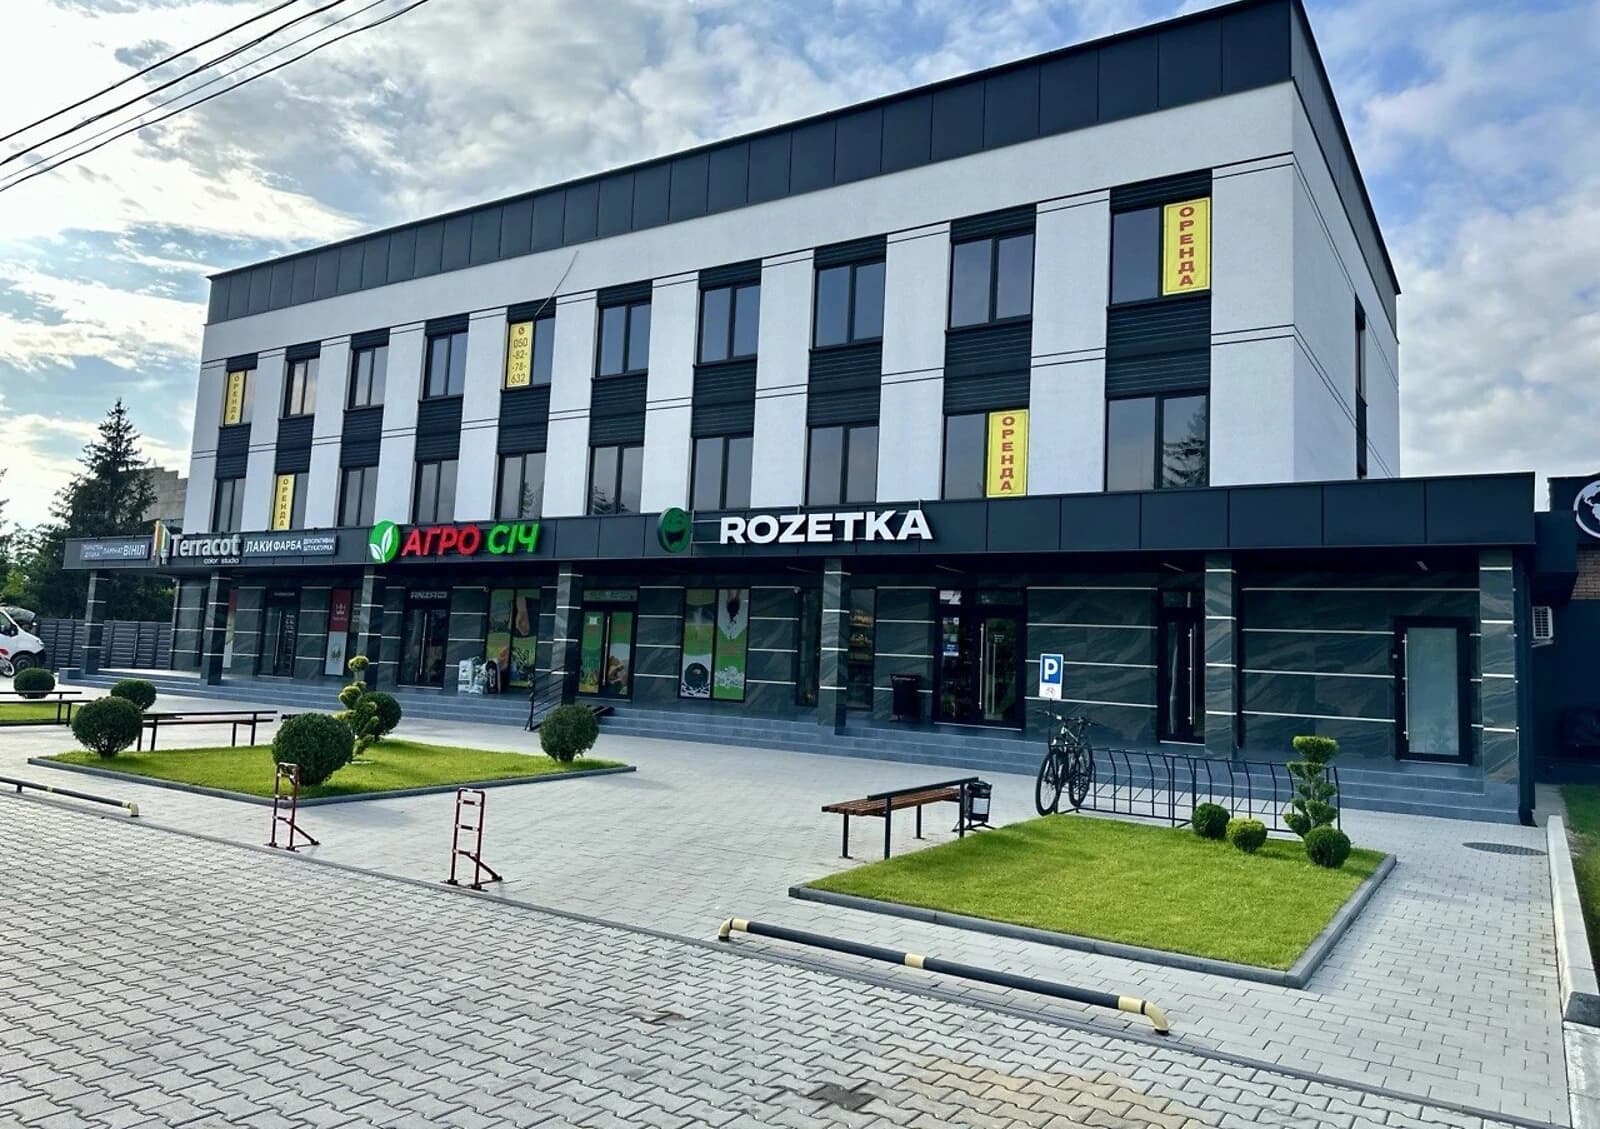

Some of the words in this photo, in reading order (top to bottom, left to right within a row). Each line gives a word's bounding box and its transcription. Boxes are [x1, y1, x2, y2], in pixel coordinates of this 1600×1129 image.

[1178, 206, 1195, 287] ОРЕНДА
[1000, 416, 1015, 491] ОРЕНДА
[279, 478, 289, 527] ОРЕНДА
[400, 524, 481, 557] АГРО
[486, 522, 539, 555] СІЧ
[719, 509, 933, 545] ROZETKA
[123, 544, 146, 557] ВІНІЛ
[170, 533, 241, 557] Terracot
[245, 540, 273, 553] ЛАКИ
[273, 540, 302, 551] ФАРБА
[1044, 658, 1059, 681] P
